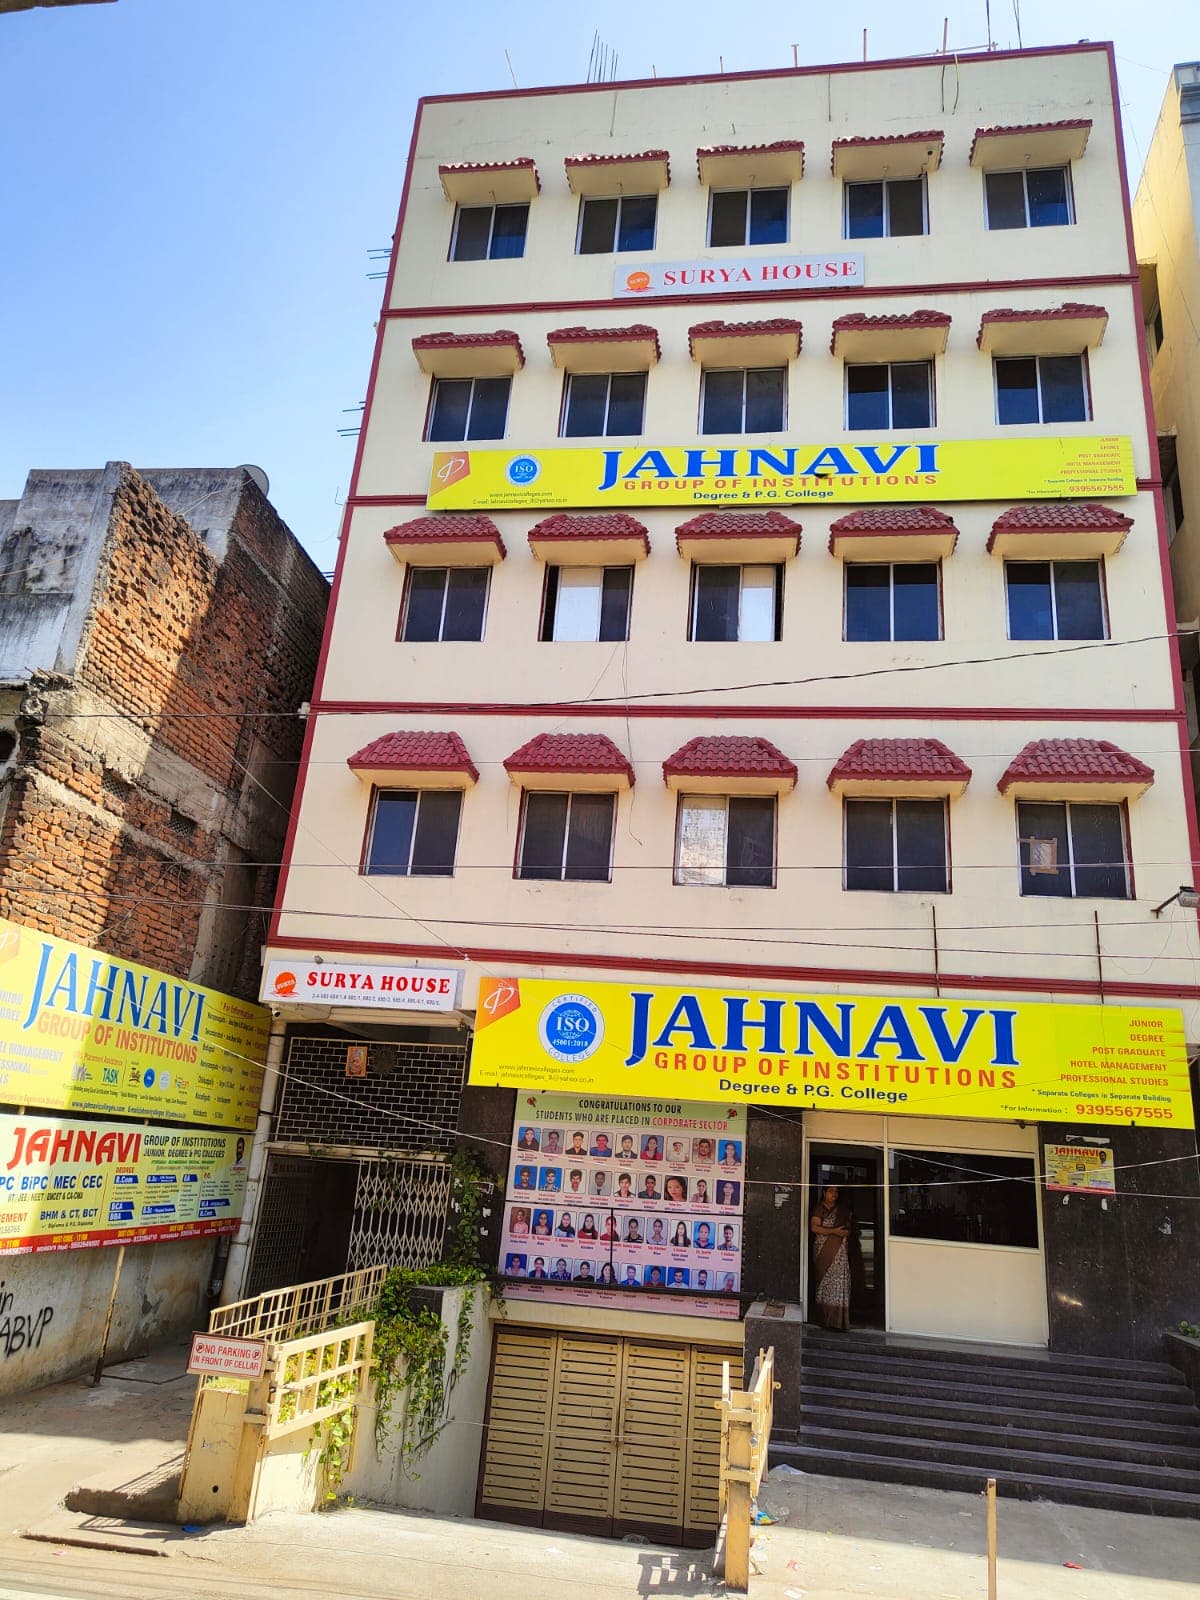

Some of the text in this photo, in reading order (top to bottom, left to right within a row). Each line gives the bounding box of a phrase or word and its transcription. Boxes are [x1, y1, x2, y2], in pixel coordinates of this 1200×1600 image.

[663, 261, 857, 286] SURYA HOUSE
[515, 465, 534, 473] ISO
[598, 444, 940, 491] JAHNAVI
[624, 474, 937, 490] GROUP OF INSTITUTIONS
[693, 489, 834, 500] Degree & P.G. College
[307, 971, 450, 993] SURYA HOUSE
[22, 942, 207, 1042] JAHNAVI
[556, 1016, 590, 1033] ISO
[624, 992, 1020, 1067] JAHNAVI
[1129, 1019, 1163, 1028] JUNIOR
[37, 1010, 91, 1041] GROUP
[94, 1023, 114, 1046] OF
[116, 1030, 198, 1065] INSTITUTIONS
[1130, 1033, 1165, 1042] DEGREE
[1092, 1047, 1166, 1057] POST GRADUATE
[654, 1051, 1016, 1090] GROUP OF INSTITUTIONS
[1070, 1060, 1167, 1072] HOTEL MANAGEMENT
[103, 1067, 119, 1084] TASK
[1060, 1073, 1169, 1087] PROFESSIONAL STUDIES
[718, 1079, 908, 1102] Degree & P.G. College
[1037, 1089, 1068, 1098] Separate
[1070, 1090, 1099, 1099] Colleges
[1109, 1092, 1141, 1102] Separate
[1143, 1094, 1171, 1103] Building
[578, 1099, 682, 1114] CONGRATULATIONS TO OUR
[1075, 1103, 1173, 1119] 9395567555
[535, 1110, 728, 1131] STUDENTS WHO ARE PLACED IN CORPORATE SECTOR
[7, 1127, 142, 1171] JAHNAVI
[144, 1135, 226, 1148] GROUP OF INSTITUTIONS
[167, 1148, 188, 1158] DEGREE
[1055, 1147, 1098, 1157] JAHNAVI
[21, 1176, 48, 1190] BiPC
[54, 1175, 77, 1189] MEC
[82, 1175, 103, 1188] CEC
[111, 1202, 123, 1210] BCA
[0, 1208, 99, 1223] EMENT BHM & CT, BCT
[0, 1306, 54, 1358] ABVP
[204, 1344, 251, 1359] NO PARKING
[192, 1355, 259, 1371] IN FRONT OF CELLAR
